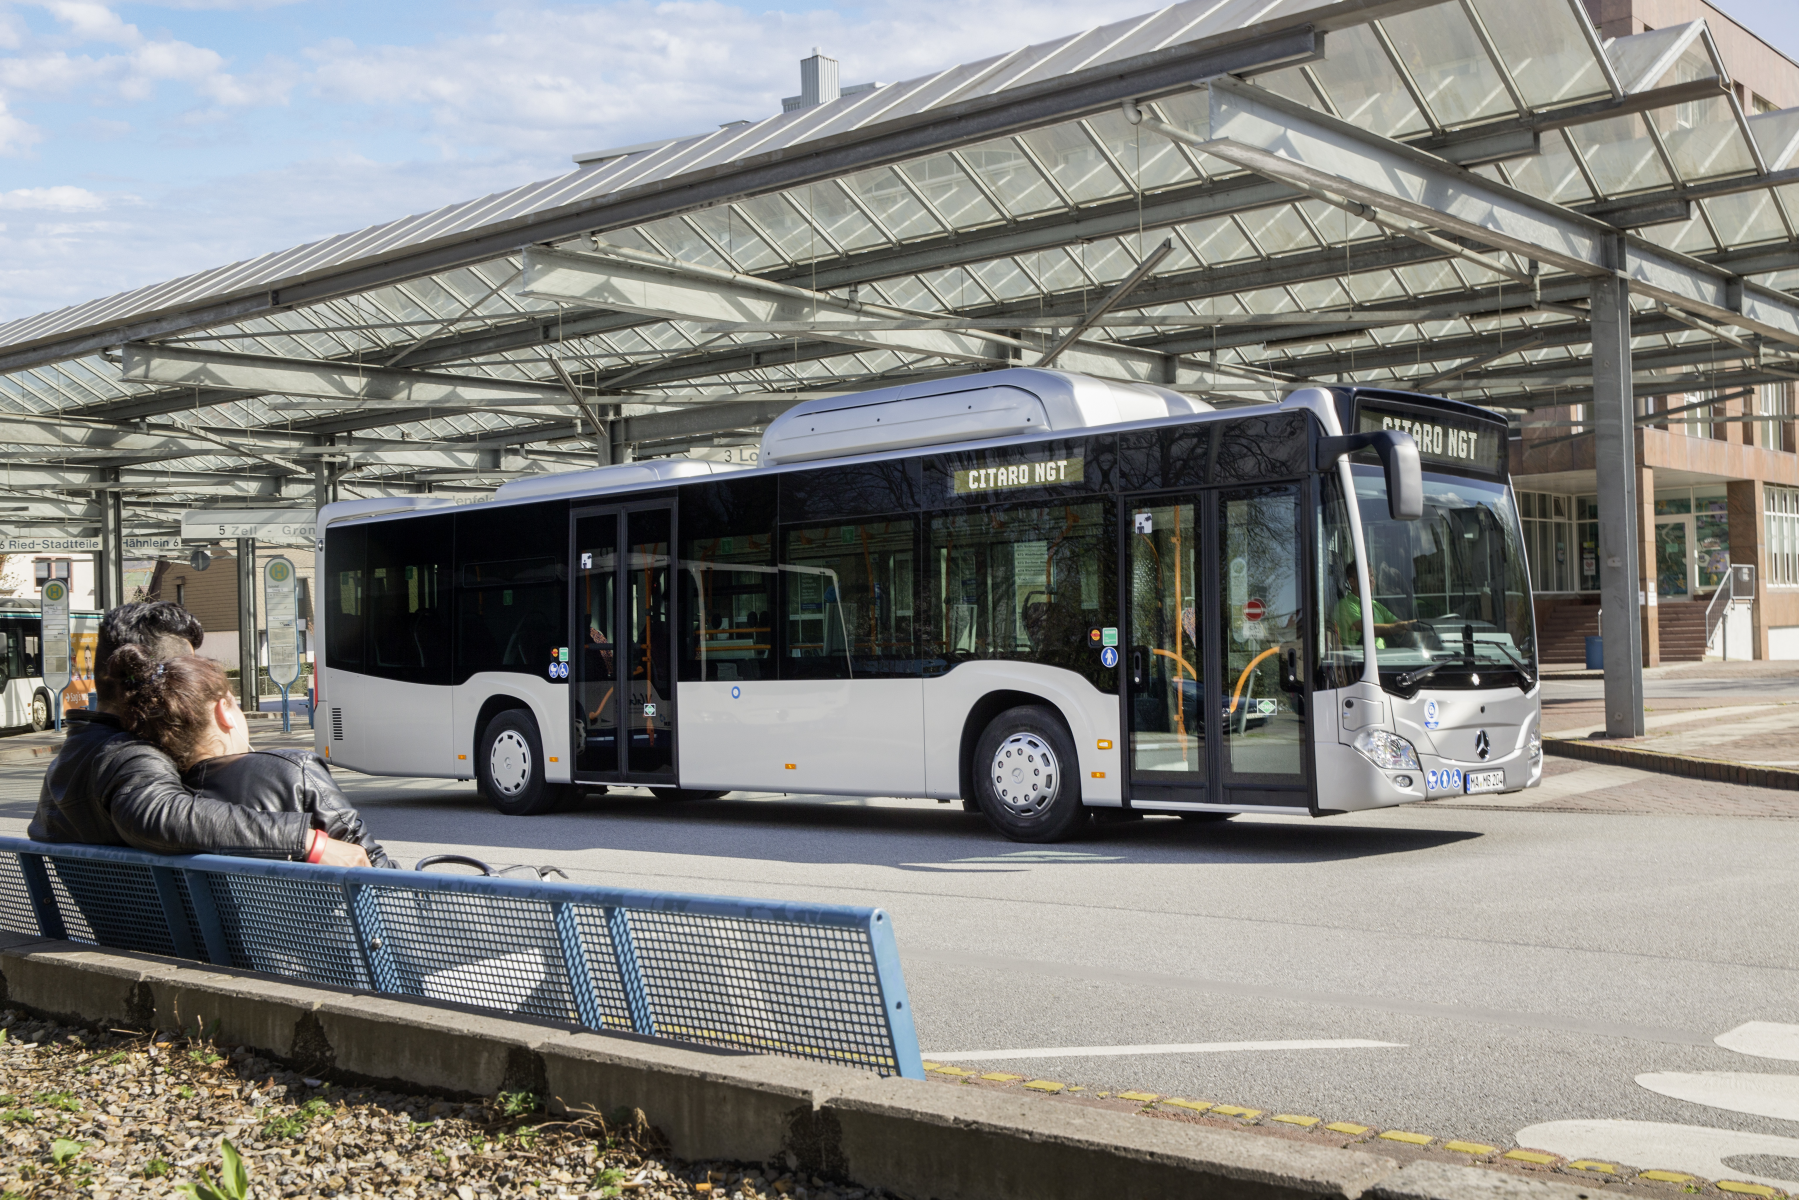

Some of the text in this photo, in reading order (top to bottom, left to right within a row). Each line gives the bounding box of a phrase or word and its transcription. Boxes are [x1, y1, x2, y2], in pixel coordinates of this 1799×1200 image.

[1448, 427, 1478, 460] NGT
[724, 449, 732, 462] 3
[968, 460, 1068, 490] CITARO NGT
[219, 525, 226, 536] 5
[231, 525, 257, 536] Zell
[0, 540, 5, 550] 6
[8, 539, 99, 550] Ried-Stadtteile
[173, 539, 179, 548] 6
